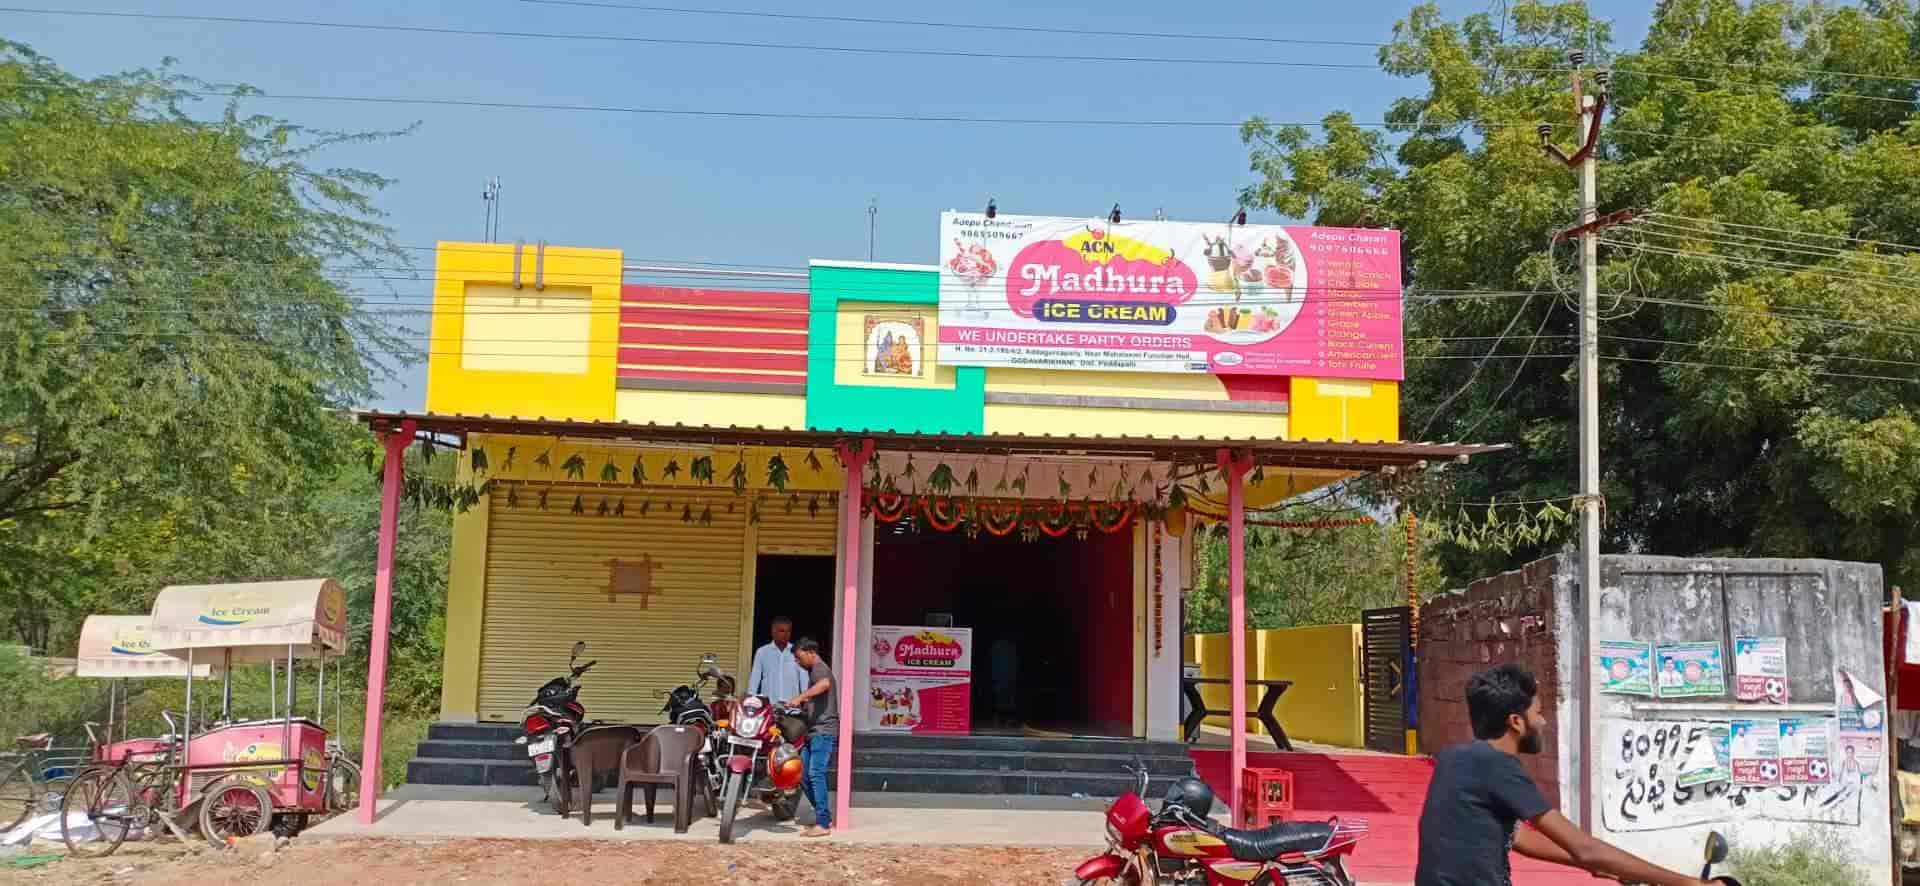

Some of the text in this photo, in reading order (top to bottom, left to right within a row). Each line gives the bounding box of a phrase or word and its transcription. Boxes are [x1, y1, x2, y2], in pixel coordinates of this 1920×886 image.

[1081, 239, 1115, 254] ACN
[1019, 262, 1186, 297] Madhura
[1043, 302, 1168, 321] ICE CREAM
[958, 329, 1192, 349] WE UNDERTAKE PARTY ORDERS
[211, 607, 227, 617] Ice
[121, 640, 137, 648] Ice
[900, 643, 959, 657] Madhura
